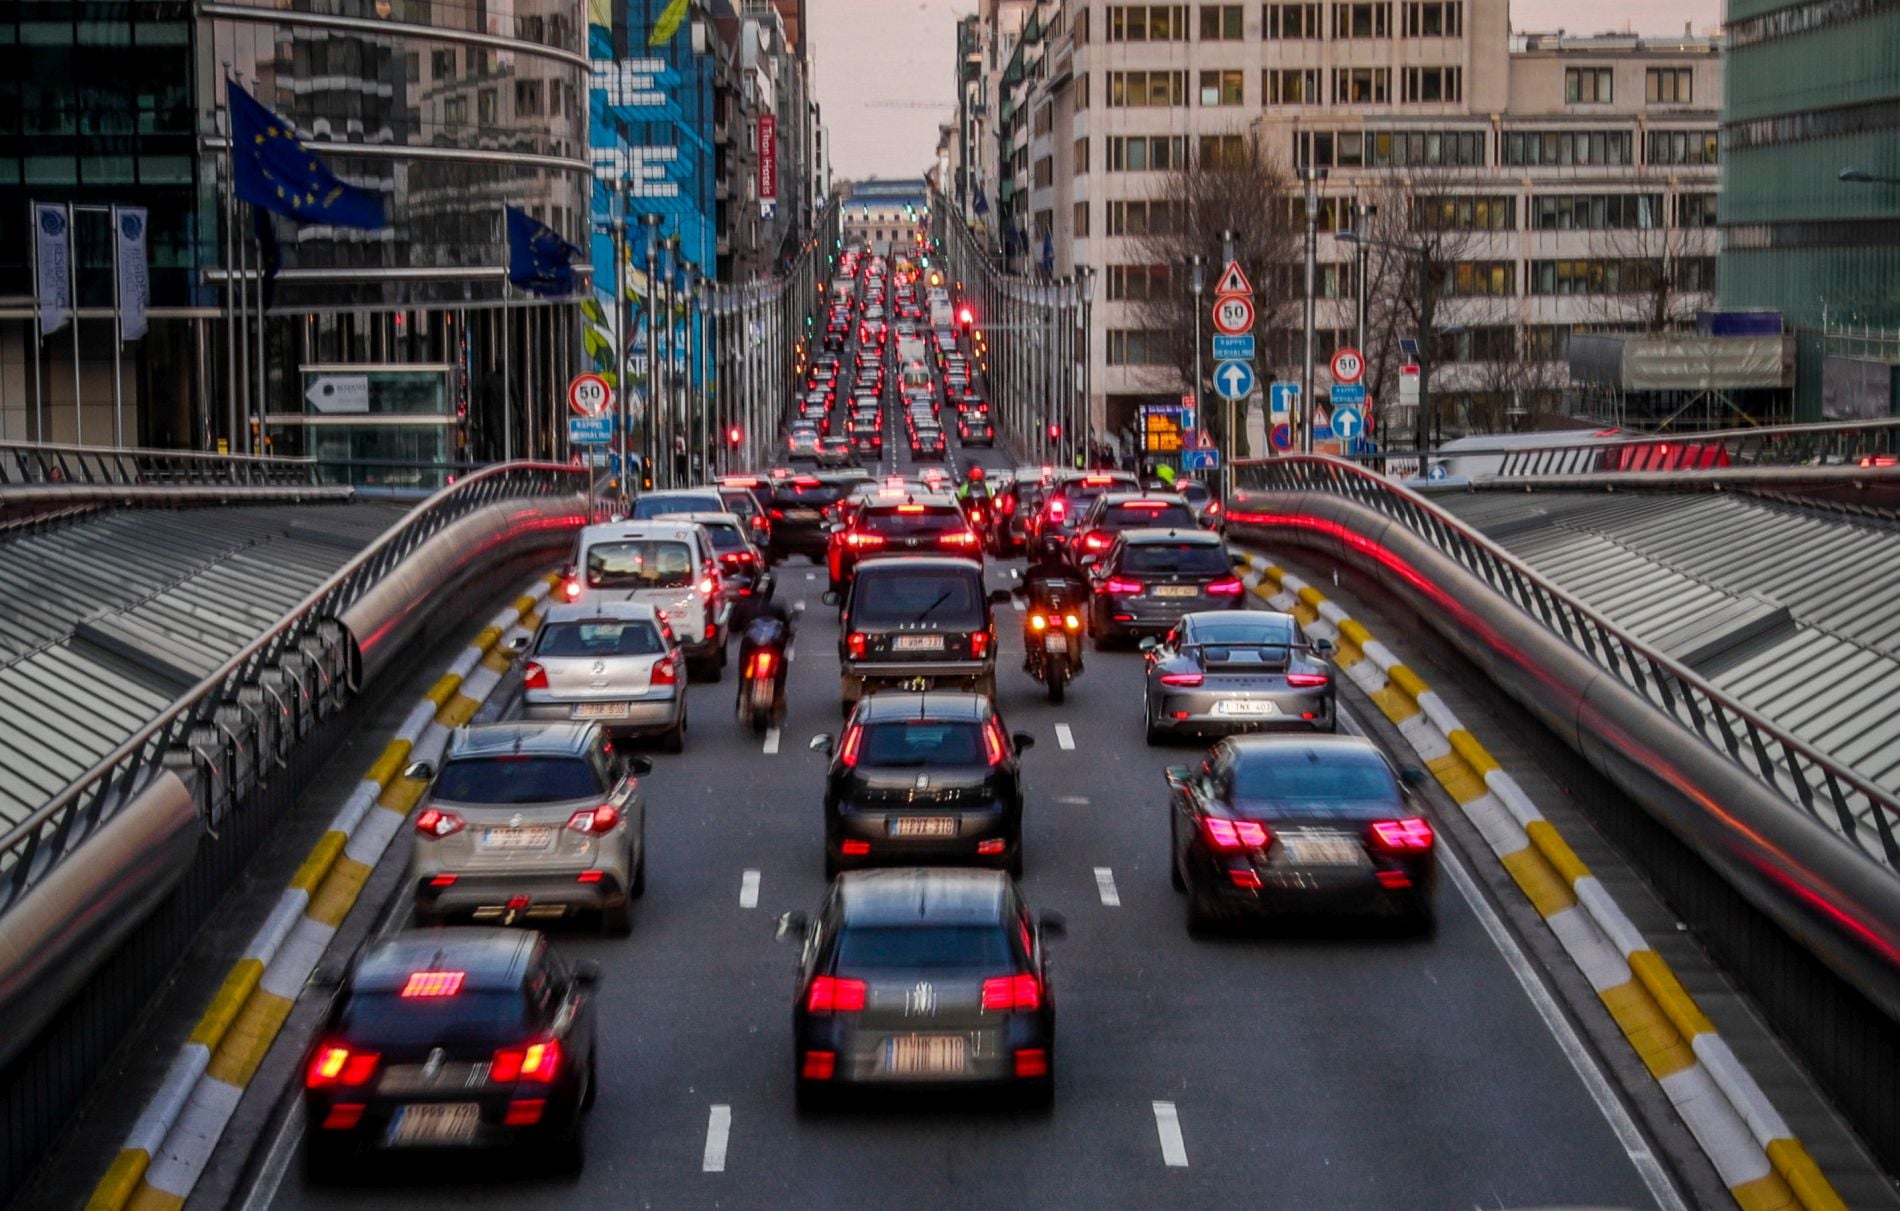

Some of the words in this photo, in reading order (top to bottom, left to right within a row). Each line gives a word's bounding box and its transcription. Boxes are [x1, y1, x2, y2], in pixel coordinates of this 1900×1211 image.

[762, 126, 773, 155] Thon
[762, 159, 773, 196] Hotels
[54, 243, 67, 311] RESIDENCE
[1224, 305, 1244, 319] 50
[1340, 358, 1356, 370] 50
[580, 385, 600, 400] 50
